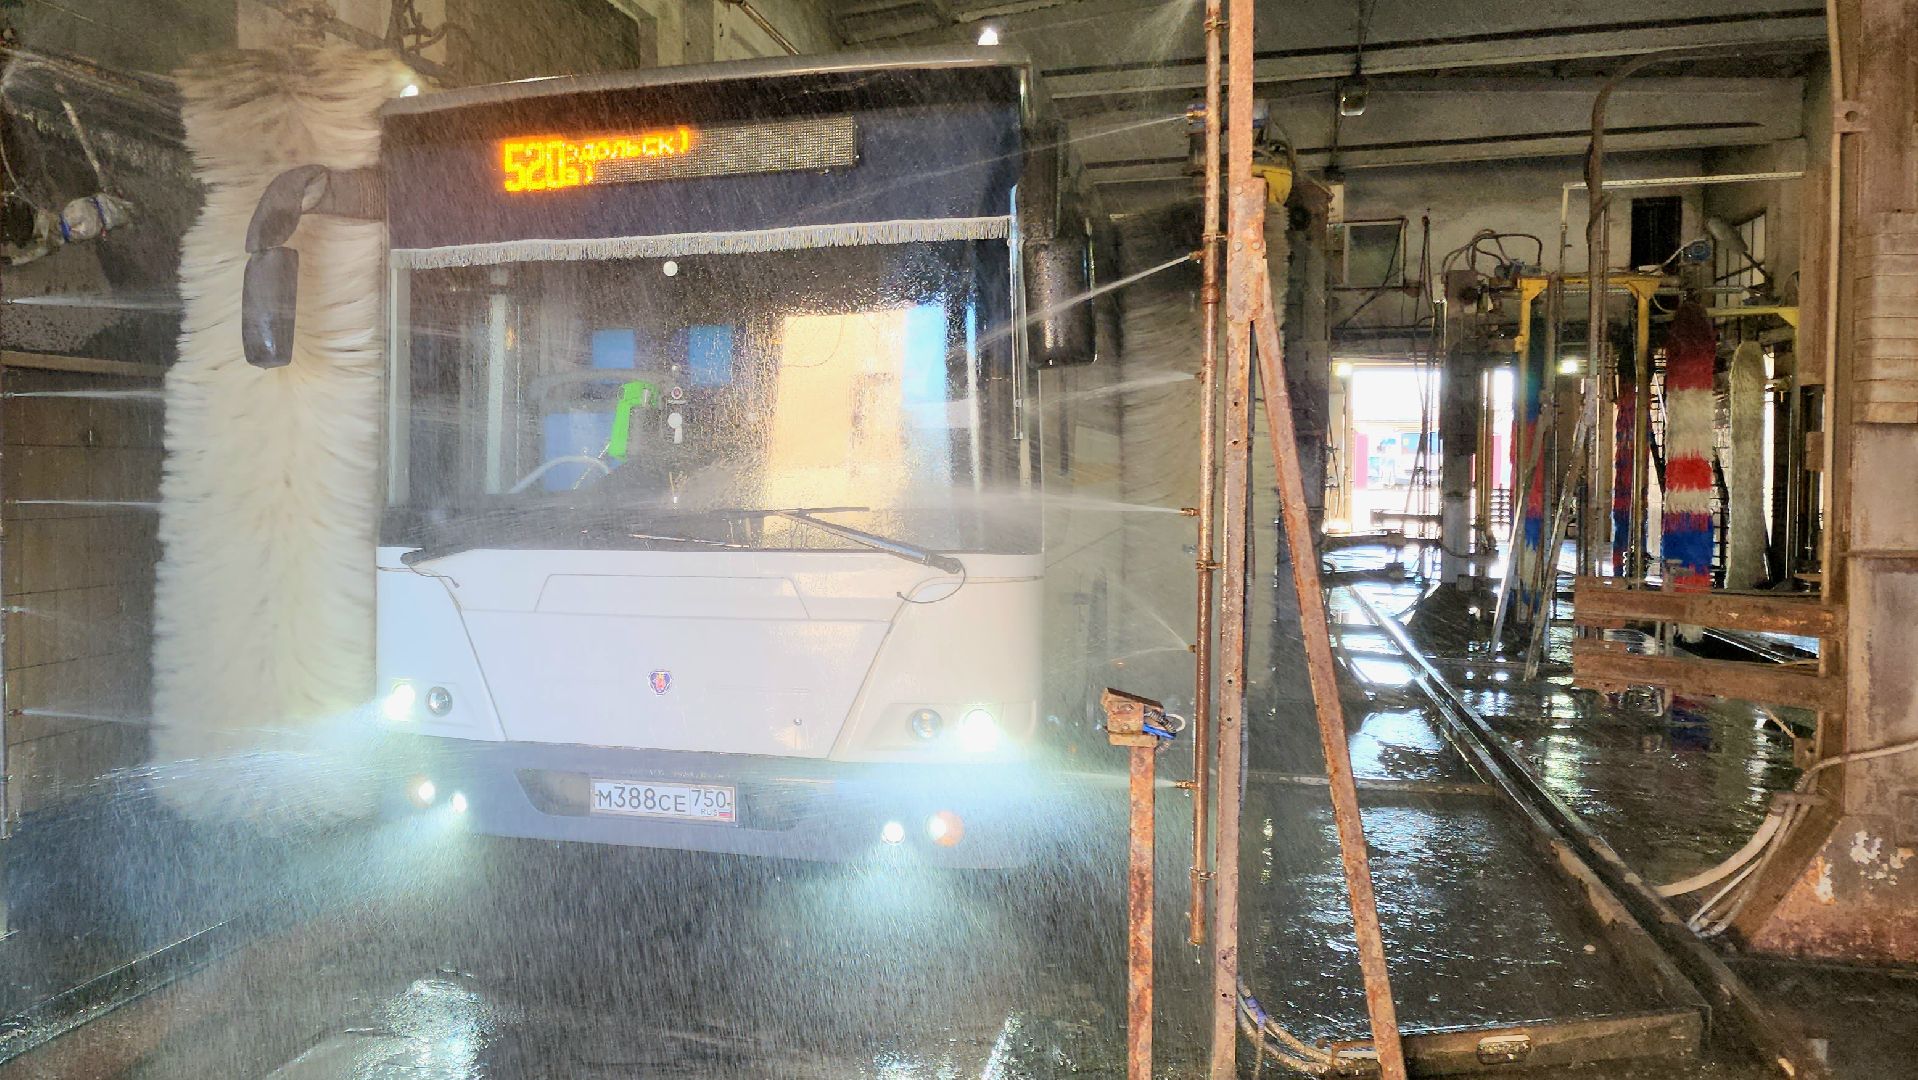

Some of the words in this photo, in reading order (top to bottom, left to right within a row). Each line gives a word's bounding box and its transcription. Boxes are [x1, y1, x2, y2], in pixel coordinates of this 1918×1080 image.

[504, 141, 565, 192] 520
[598, 786, 686, 812] М388СЕ
[691, 789, 727, 809] 750
[700, 808, 718, 817] RUS
